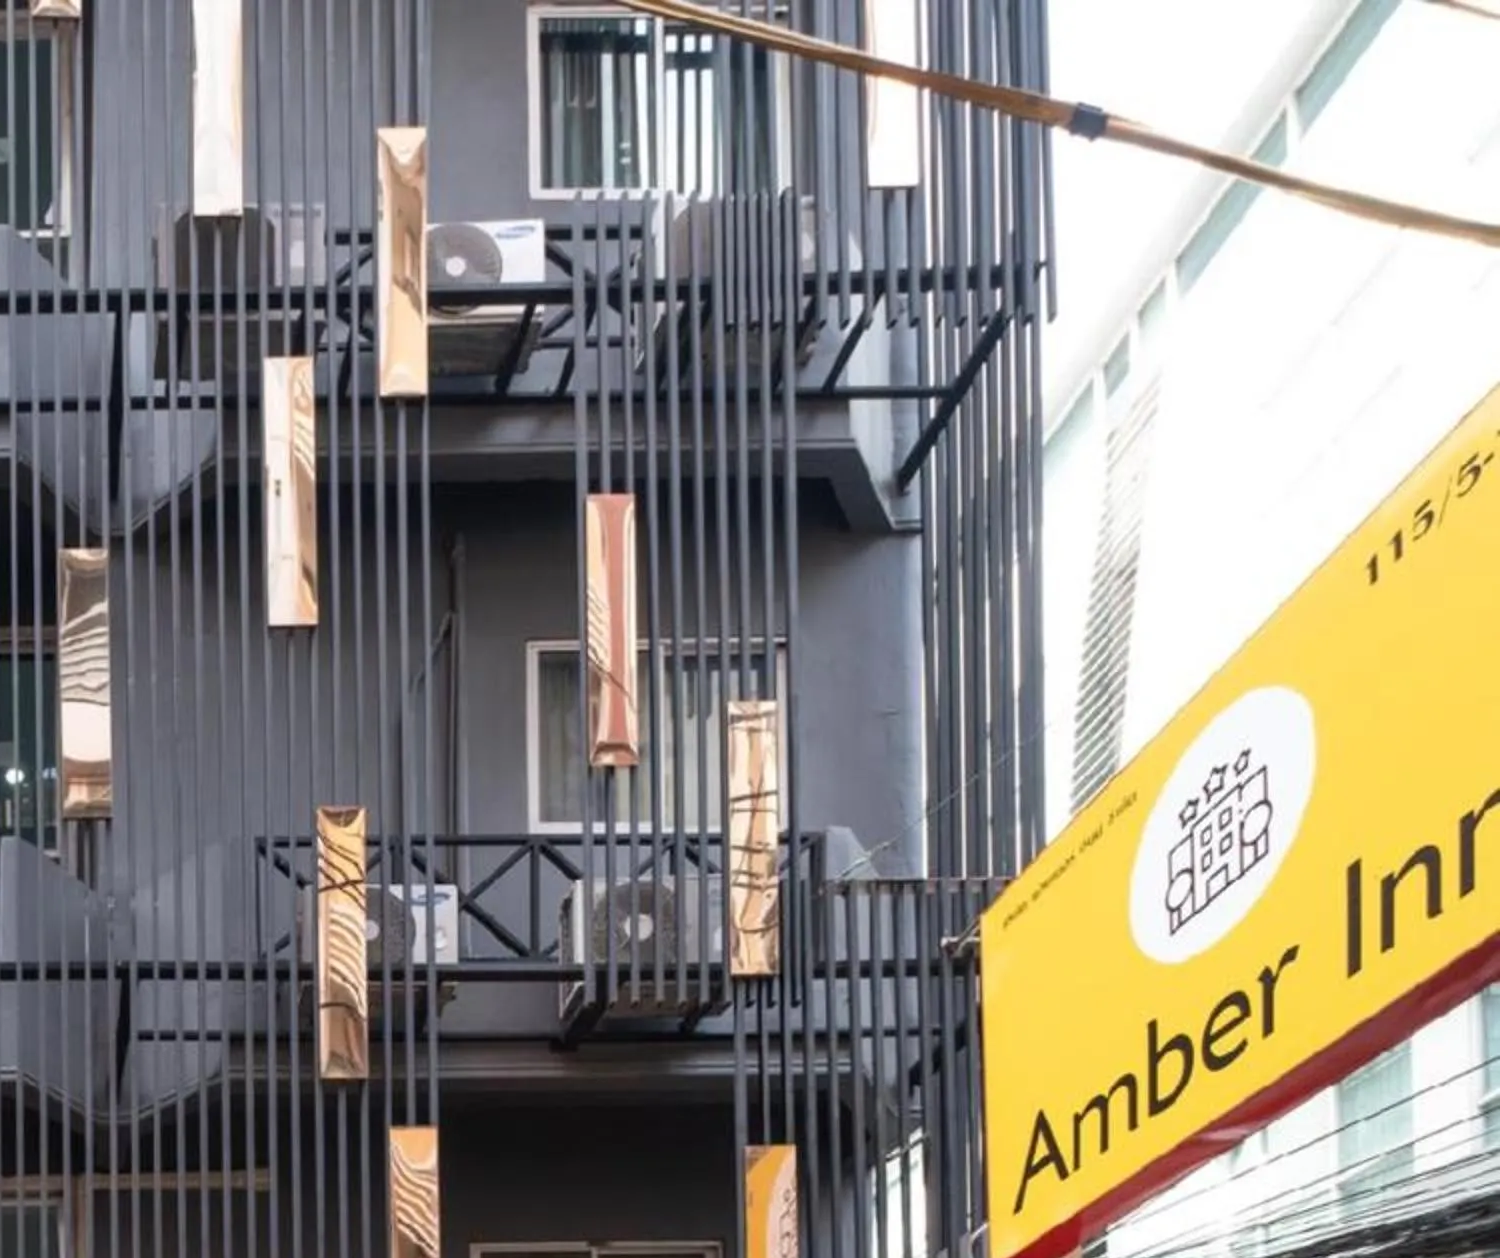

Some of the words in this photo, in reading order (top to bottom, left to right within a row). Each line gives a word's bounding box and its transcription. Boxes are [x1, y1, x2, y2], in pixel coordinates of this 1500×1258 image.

[1365, 430, 1500, 586] 115/5-
[1013, 944, 1300, 1215] Amber
[1346, 787, 1500, 979] Inn
